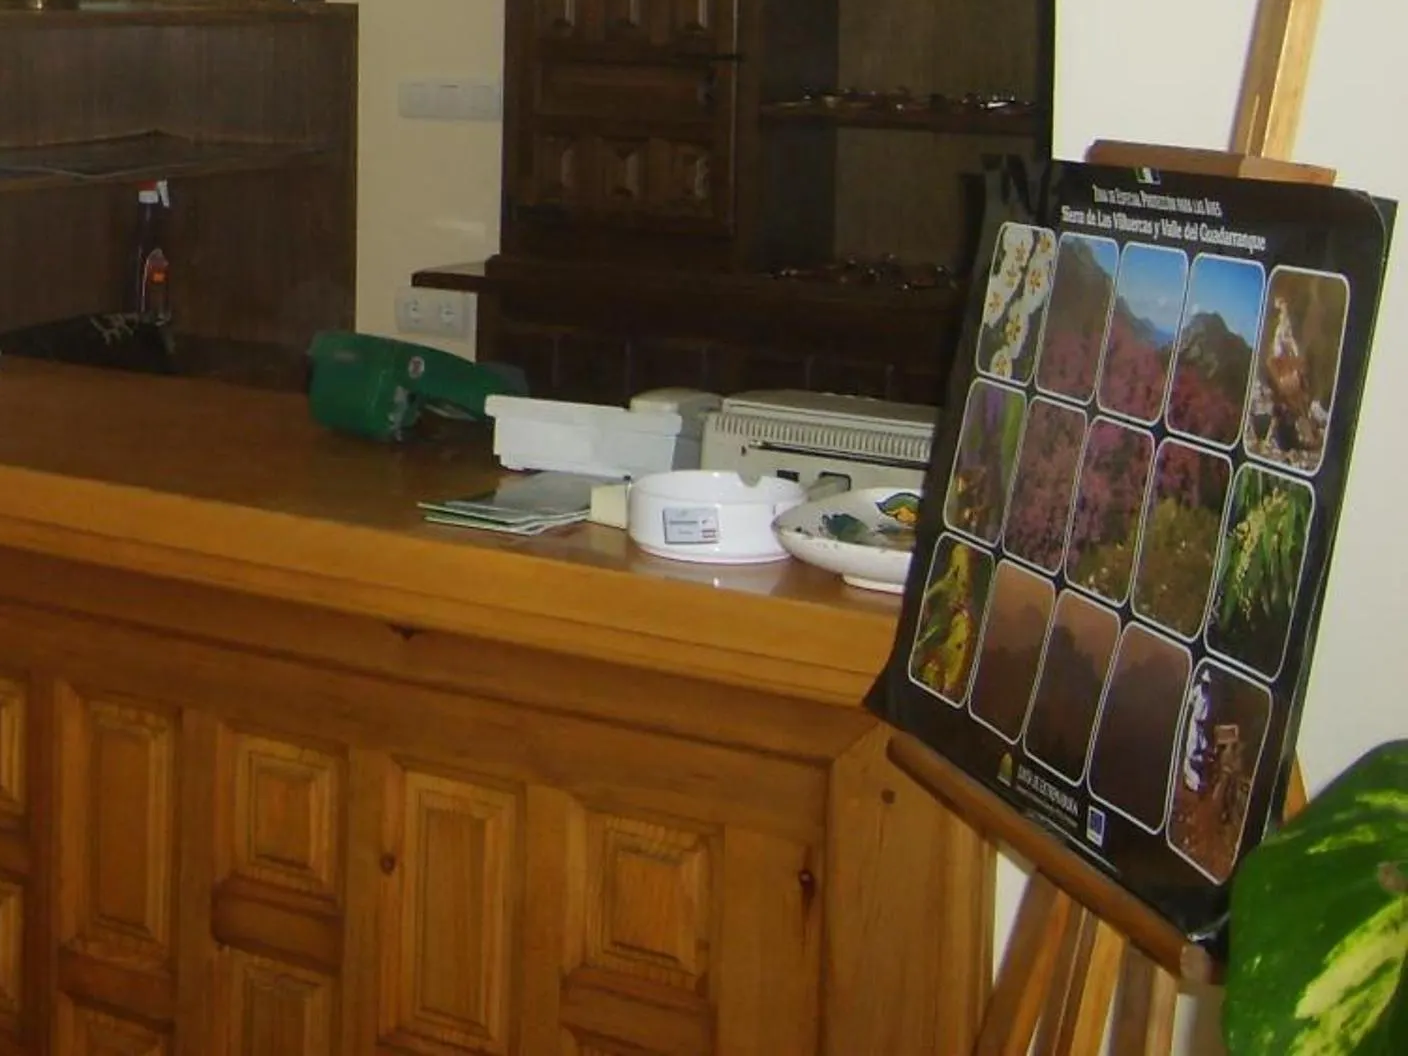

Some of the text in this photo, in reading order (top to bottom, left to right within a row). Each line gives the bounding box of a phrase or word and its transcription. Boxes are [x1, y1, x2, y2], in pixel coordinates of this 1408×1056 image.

[1086, 207, 1096, 225] de
[1153, 221, 1160, 241] y
[1160, 218, 1182, 239] Valle
[1184, 221, 1198, 241] del
